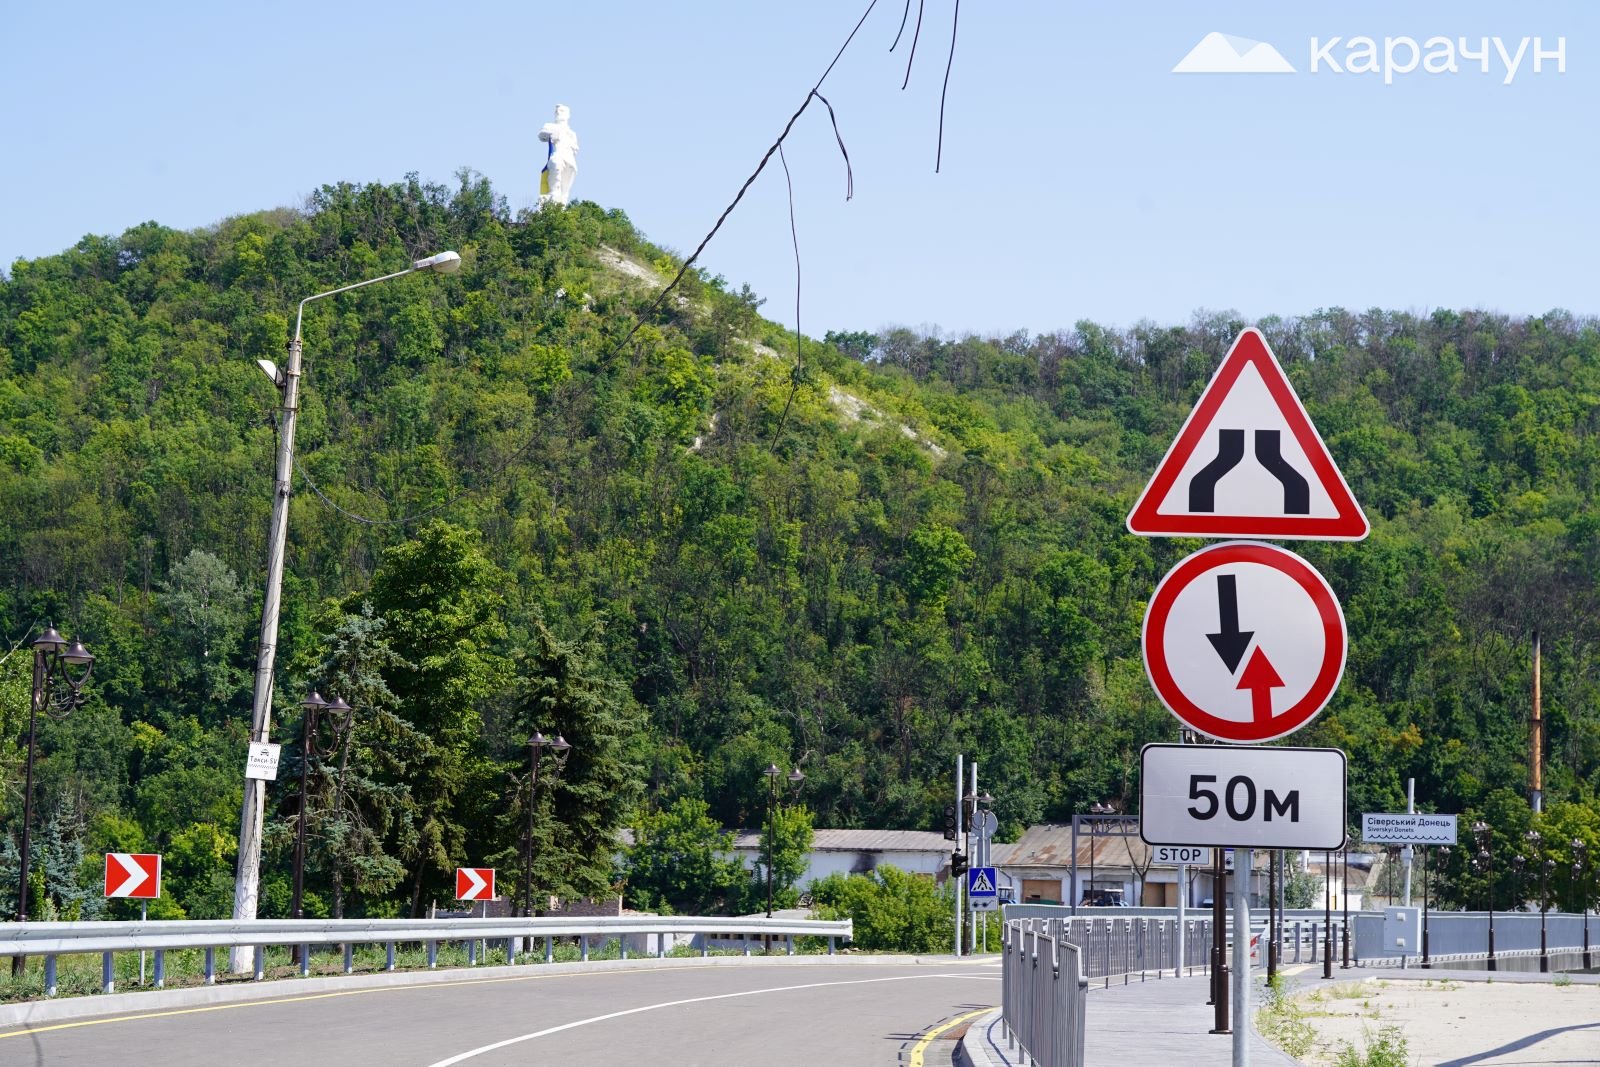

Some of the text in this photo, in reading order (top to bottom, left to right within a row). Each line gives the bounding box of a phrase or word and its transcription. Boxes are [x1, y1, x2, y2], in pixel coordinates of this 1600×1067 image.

[1187, 774, 1300, 823] 50м
[1367, 817, 1451, 827] Сіверський Донець
[1159, 848, 1201, 861] STOP
